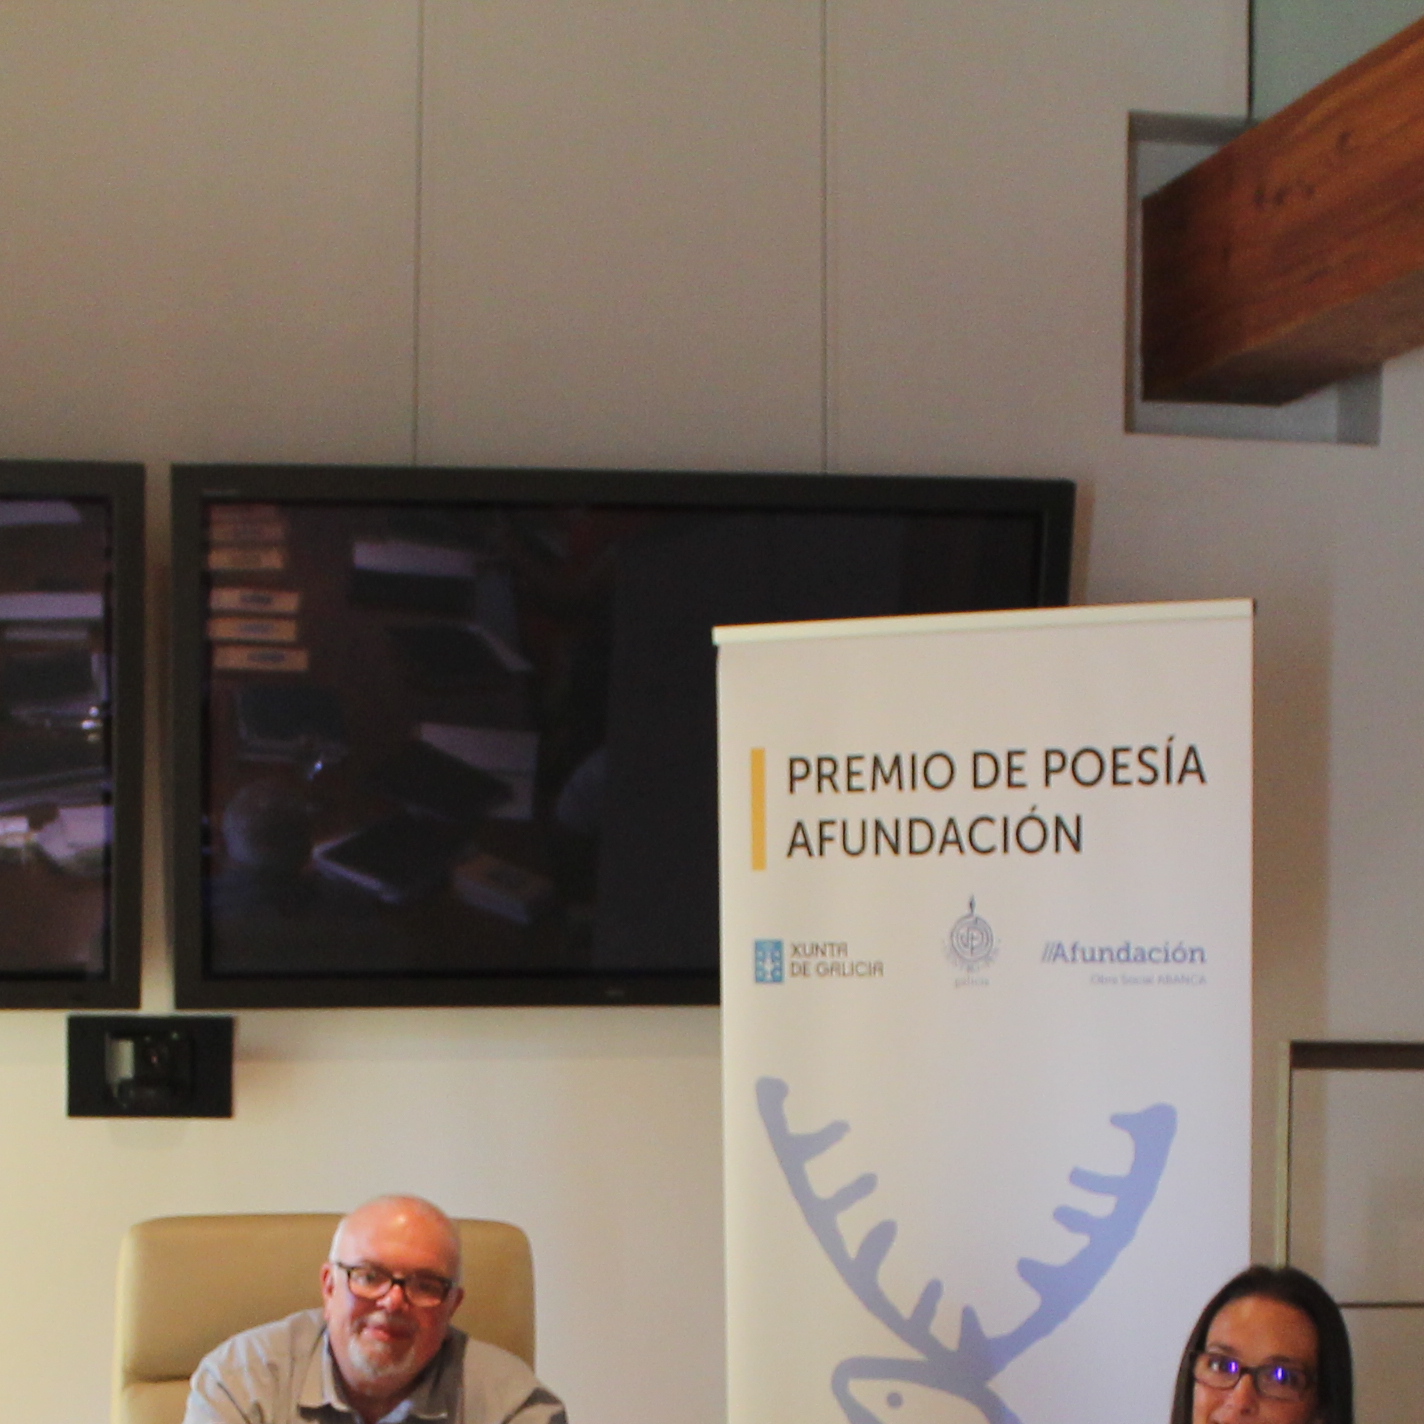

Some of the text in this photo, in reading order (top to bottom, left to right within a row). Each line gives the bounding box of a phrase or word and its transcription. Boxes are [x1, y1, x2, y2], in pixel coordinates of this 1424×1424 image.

[788, 736, 1207, 794] PREMIO DE POESÍA
[786, 805, 1084, 858] AFUNDACIÓN
[790, 942, 848, 958] XUNTA
[790, 961, 884, 977] DE GALICIA
